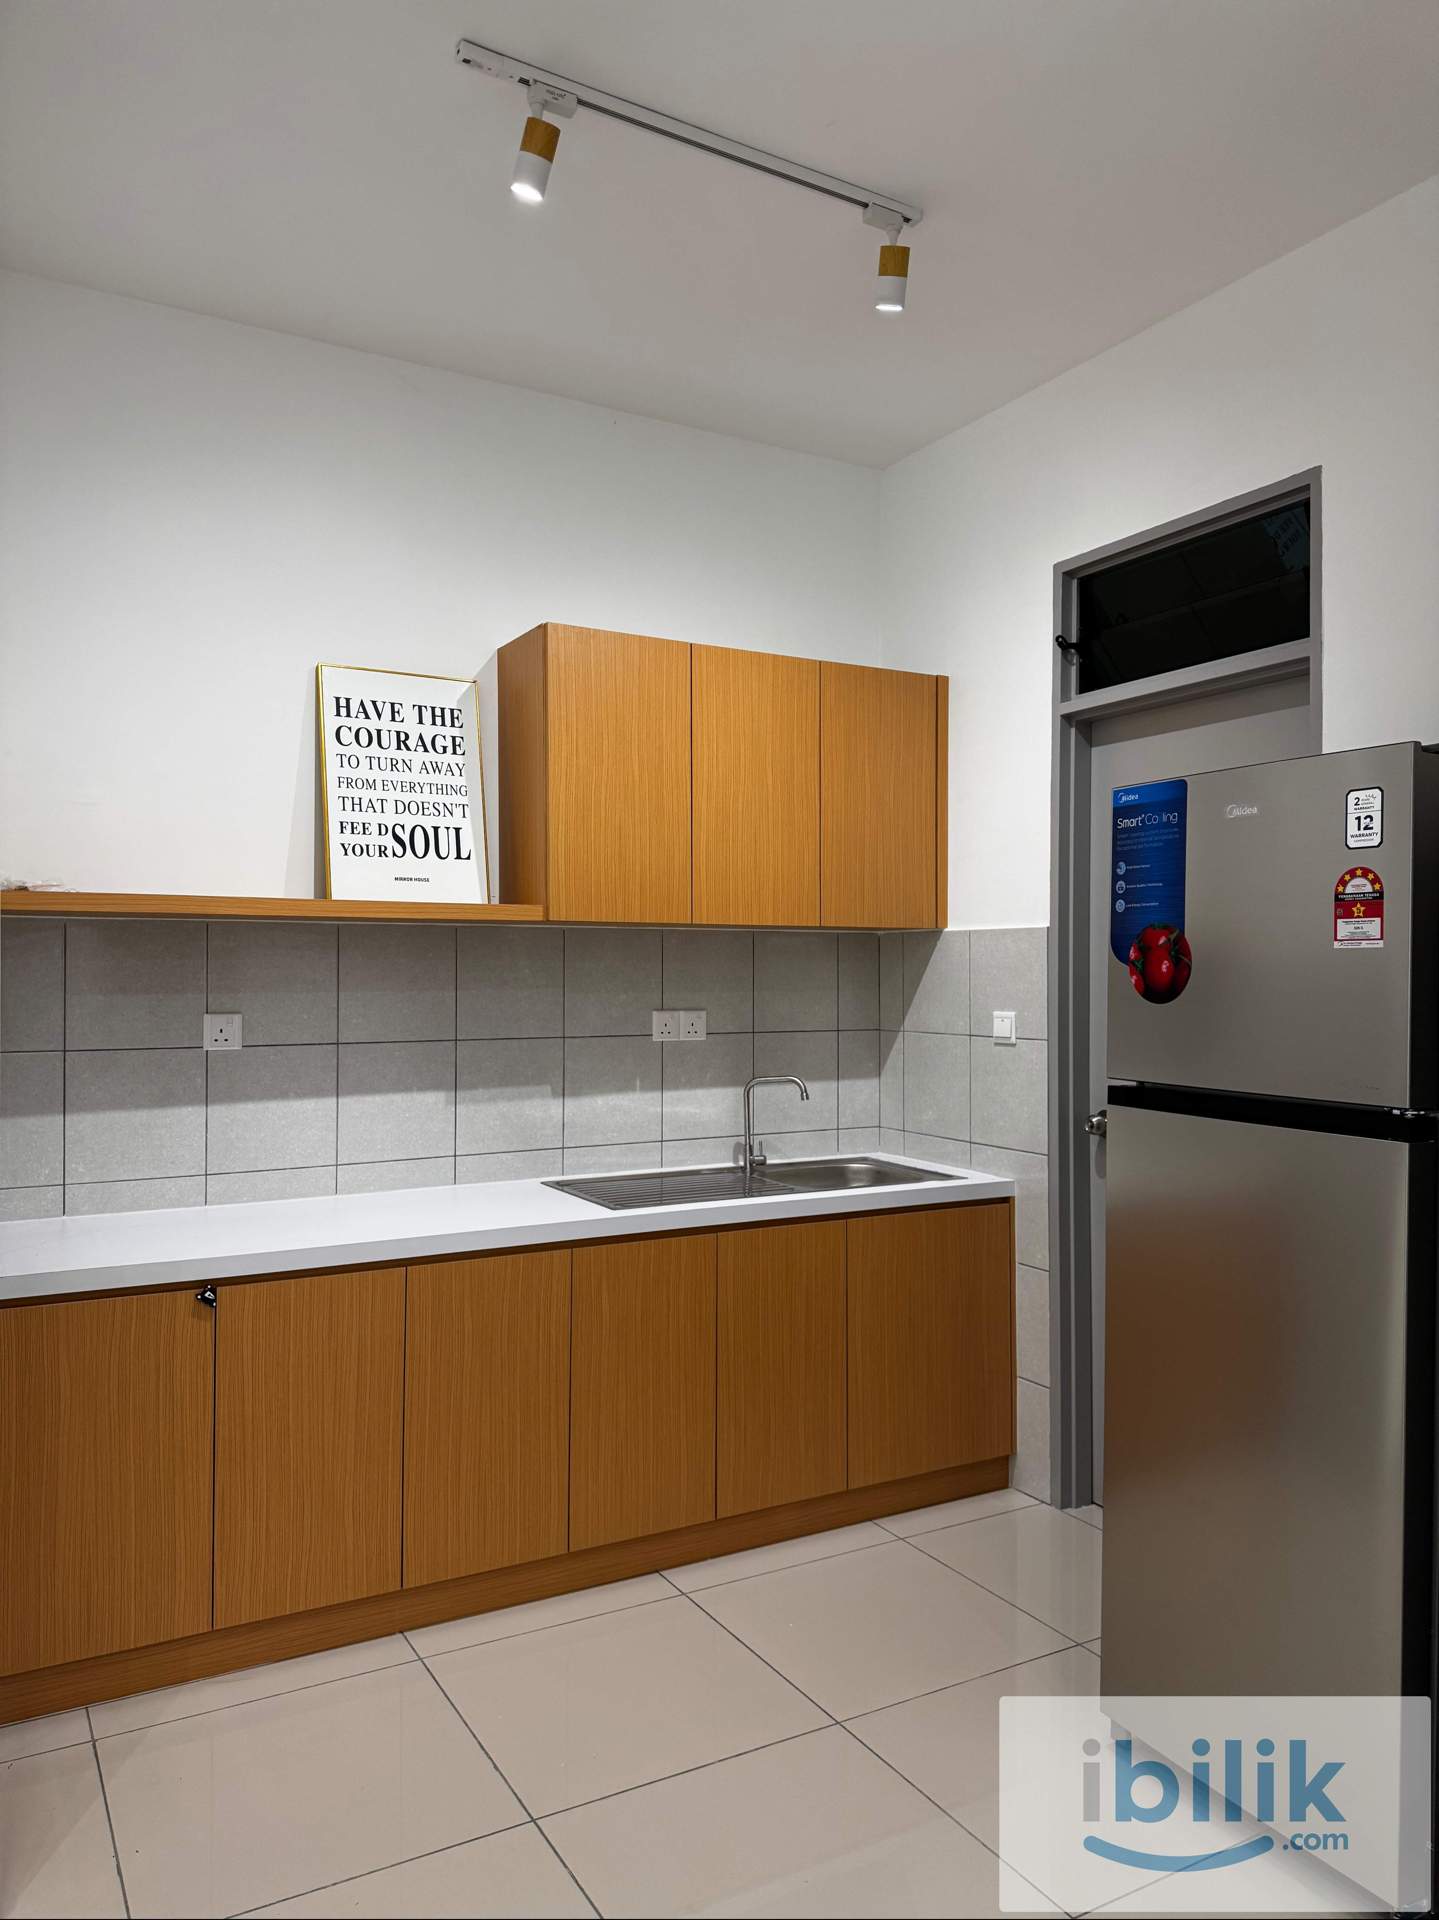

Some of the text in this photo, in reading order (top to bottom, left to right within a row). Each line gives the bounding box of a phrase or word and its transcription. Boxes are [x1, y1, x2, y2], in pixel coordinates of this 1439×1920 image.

[333, 695, 464, 729] HAVE THE
[335, 725, 466, 756] COURAGE
[336, 753, 465, 777] TO TURN AWAY
[337, 776, 468, 797] FROM EVERYTHING
[338, 796, 469, 819] THAT DOESN'T
[1353, 796, 1361, 807] 2
[1354, 814, 1374, 832] 12
[340, 823, 472, 861] YOUR SOUL
